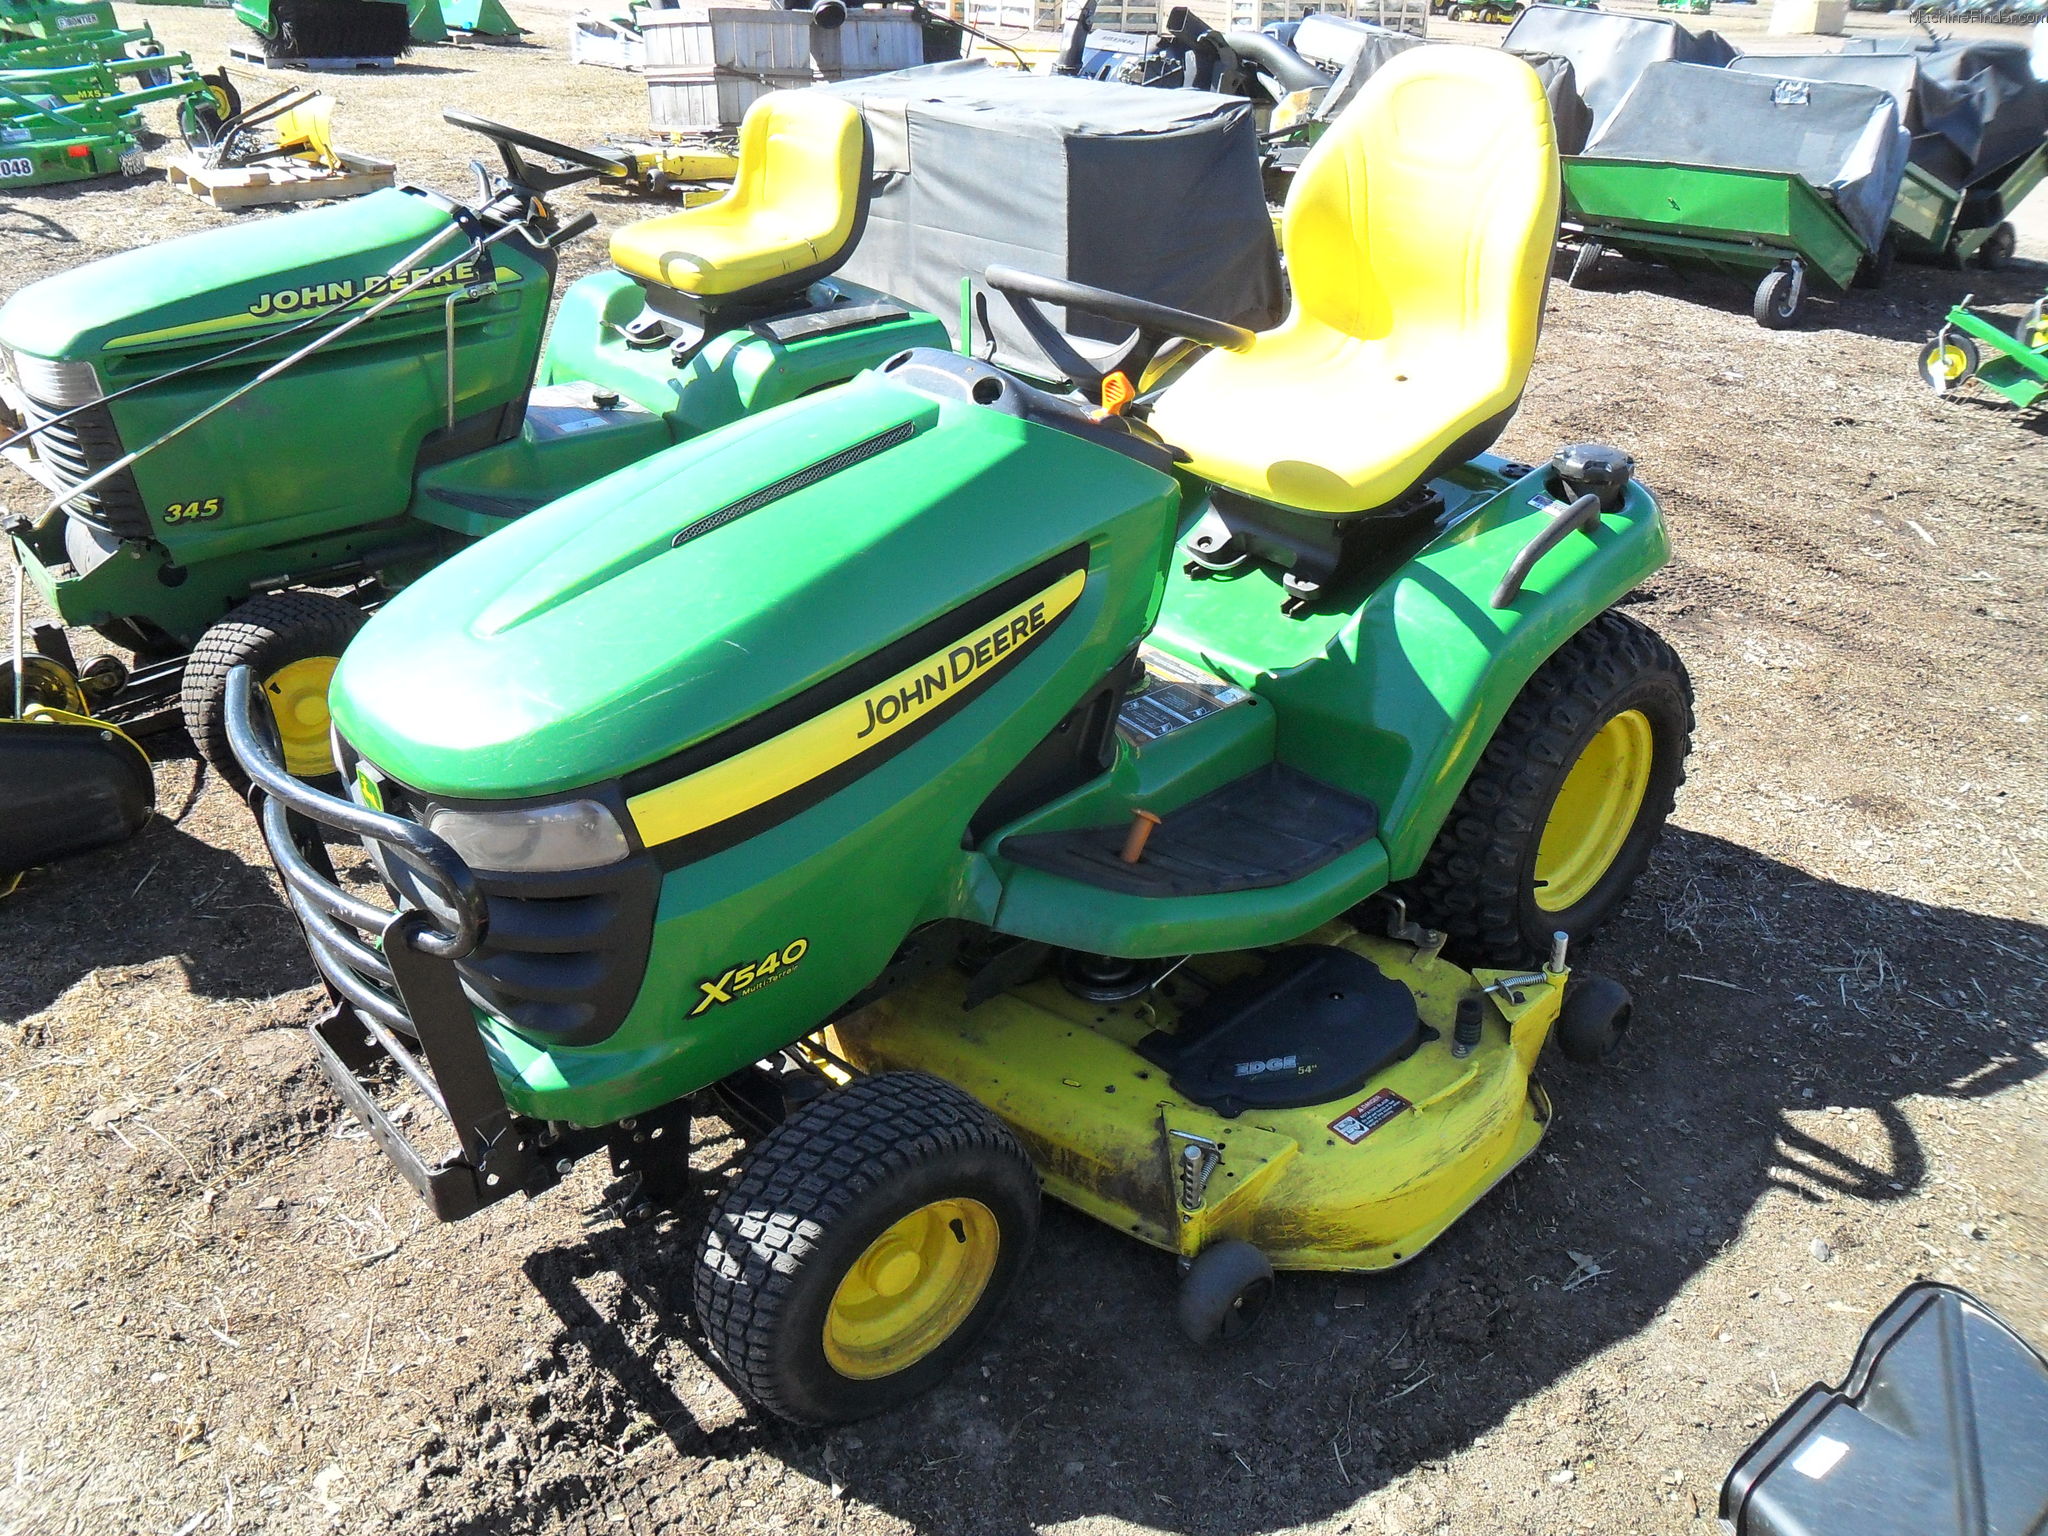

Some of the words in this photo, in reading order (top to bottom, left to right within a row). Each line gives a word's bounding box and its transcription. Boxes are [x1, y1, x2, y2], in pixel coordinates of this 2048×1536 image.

[0, 158, 32, 176] 048
[249, 280, 354, 315] JOHN
[164, 498, 221, 523] 345
[857, 665, 947, 739] JOHN
[948, 602, 1046, 684] DEERE
[690, 938, 808, 1016] X540
[1234, 1055, 1297, 1077] EDGE
